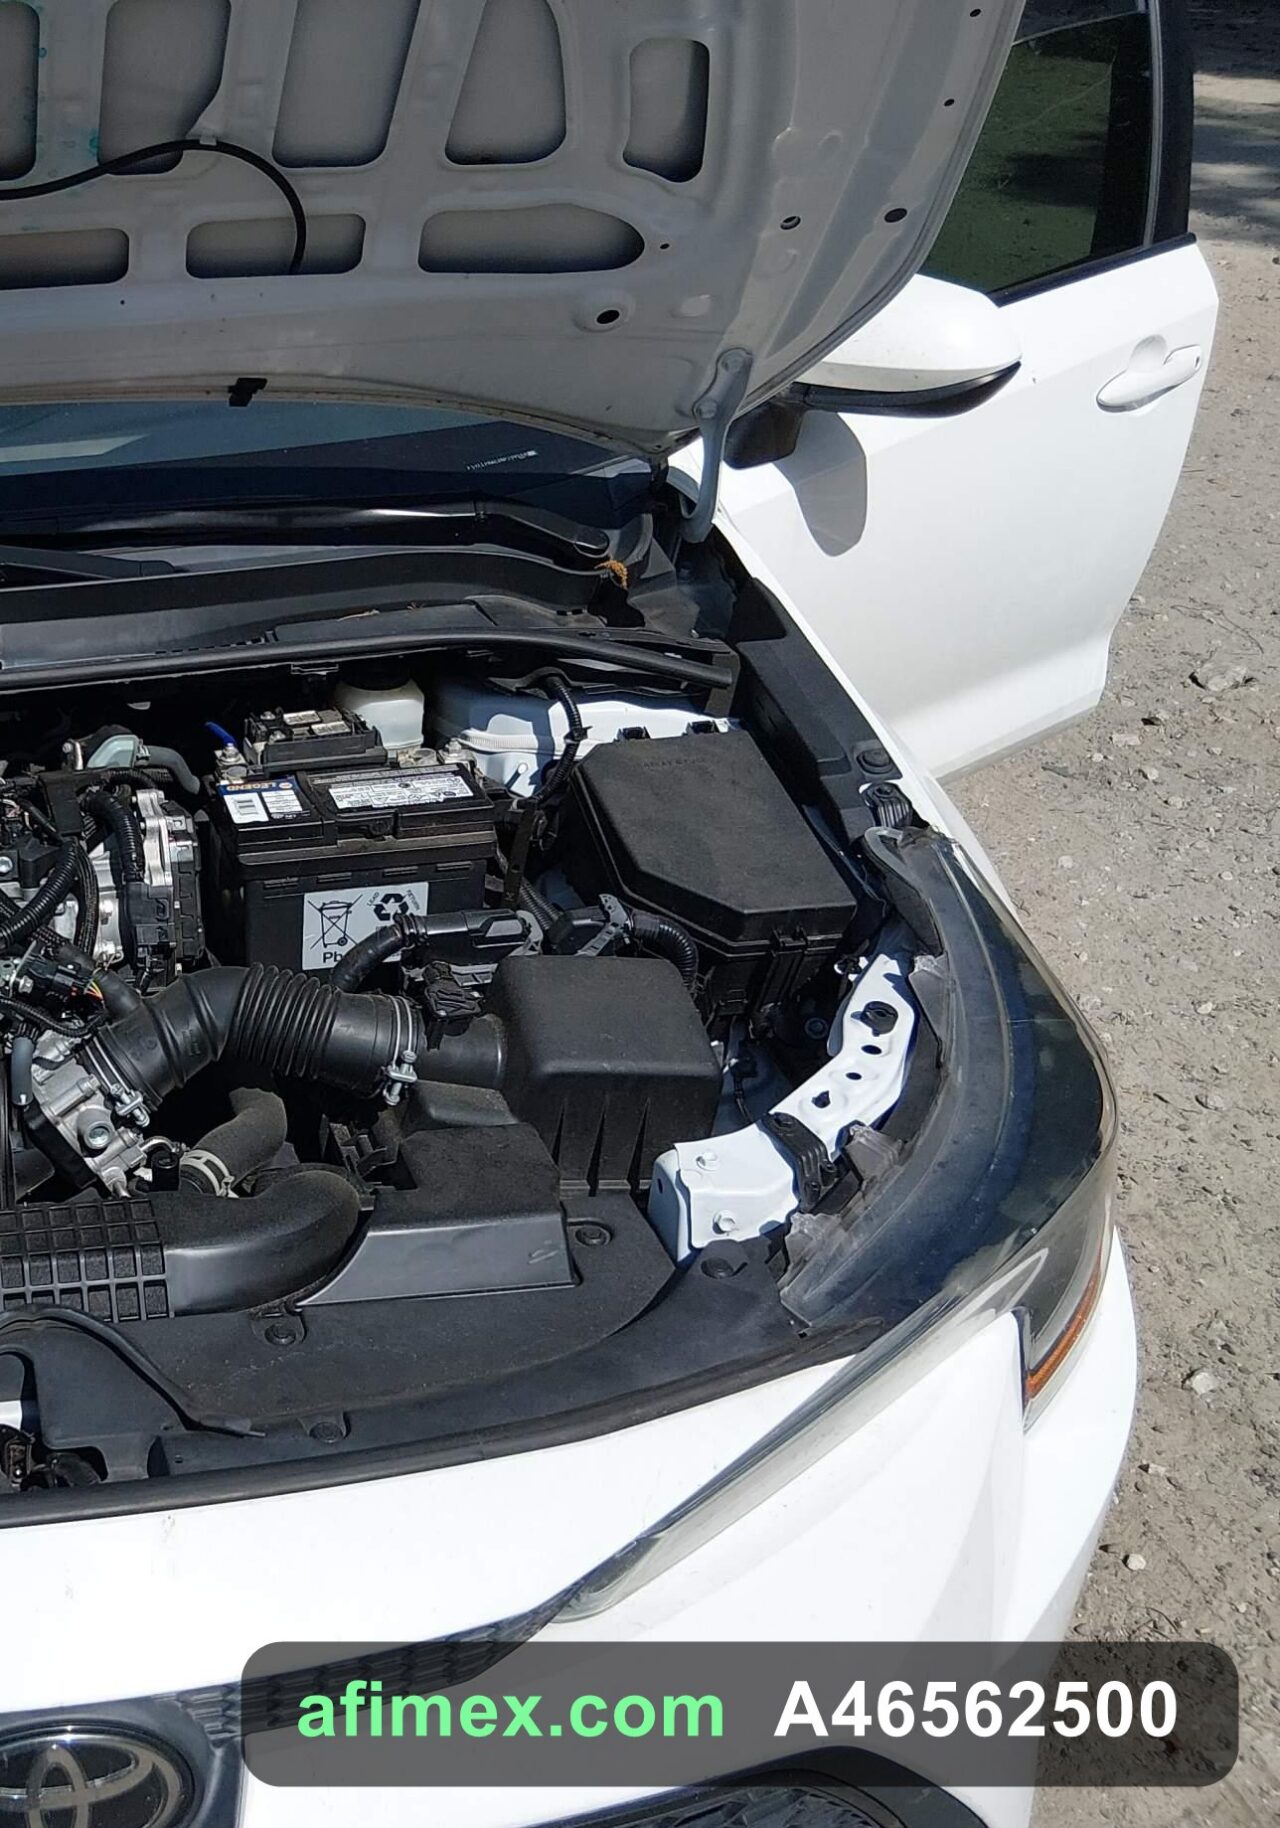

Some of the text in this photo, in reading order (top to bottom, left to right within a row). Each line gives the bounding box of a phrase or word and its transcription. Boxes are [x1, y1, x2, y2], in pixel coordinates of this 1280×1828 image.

[226, 782, 277, 791] LEGEND
[366, 891, 380, 906] LEAD
[322, 951, 343, 964] Pb
